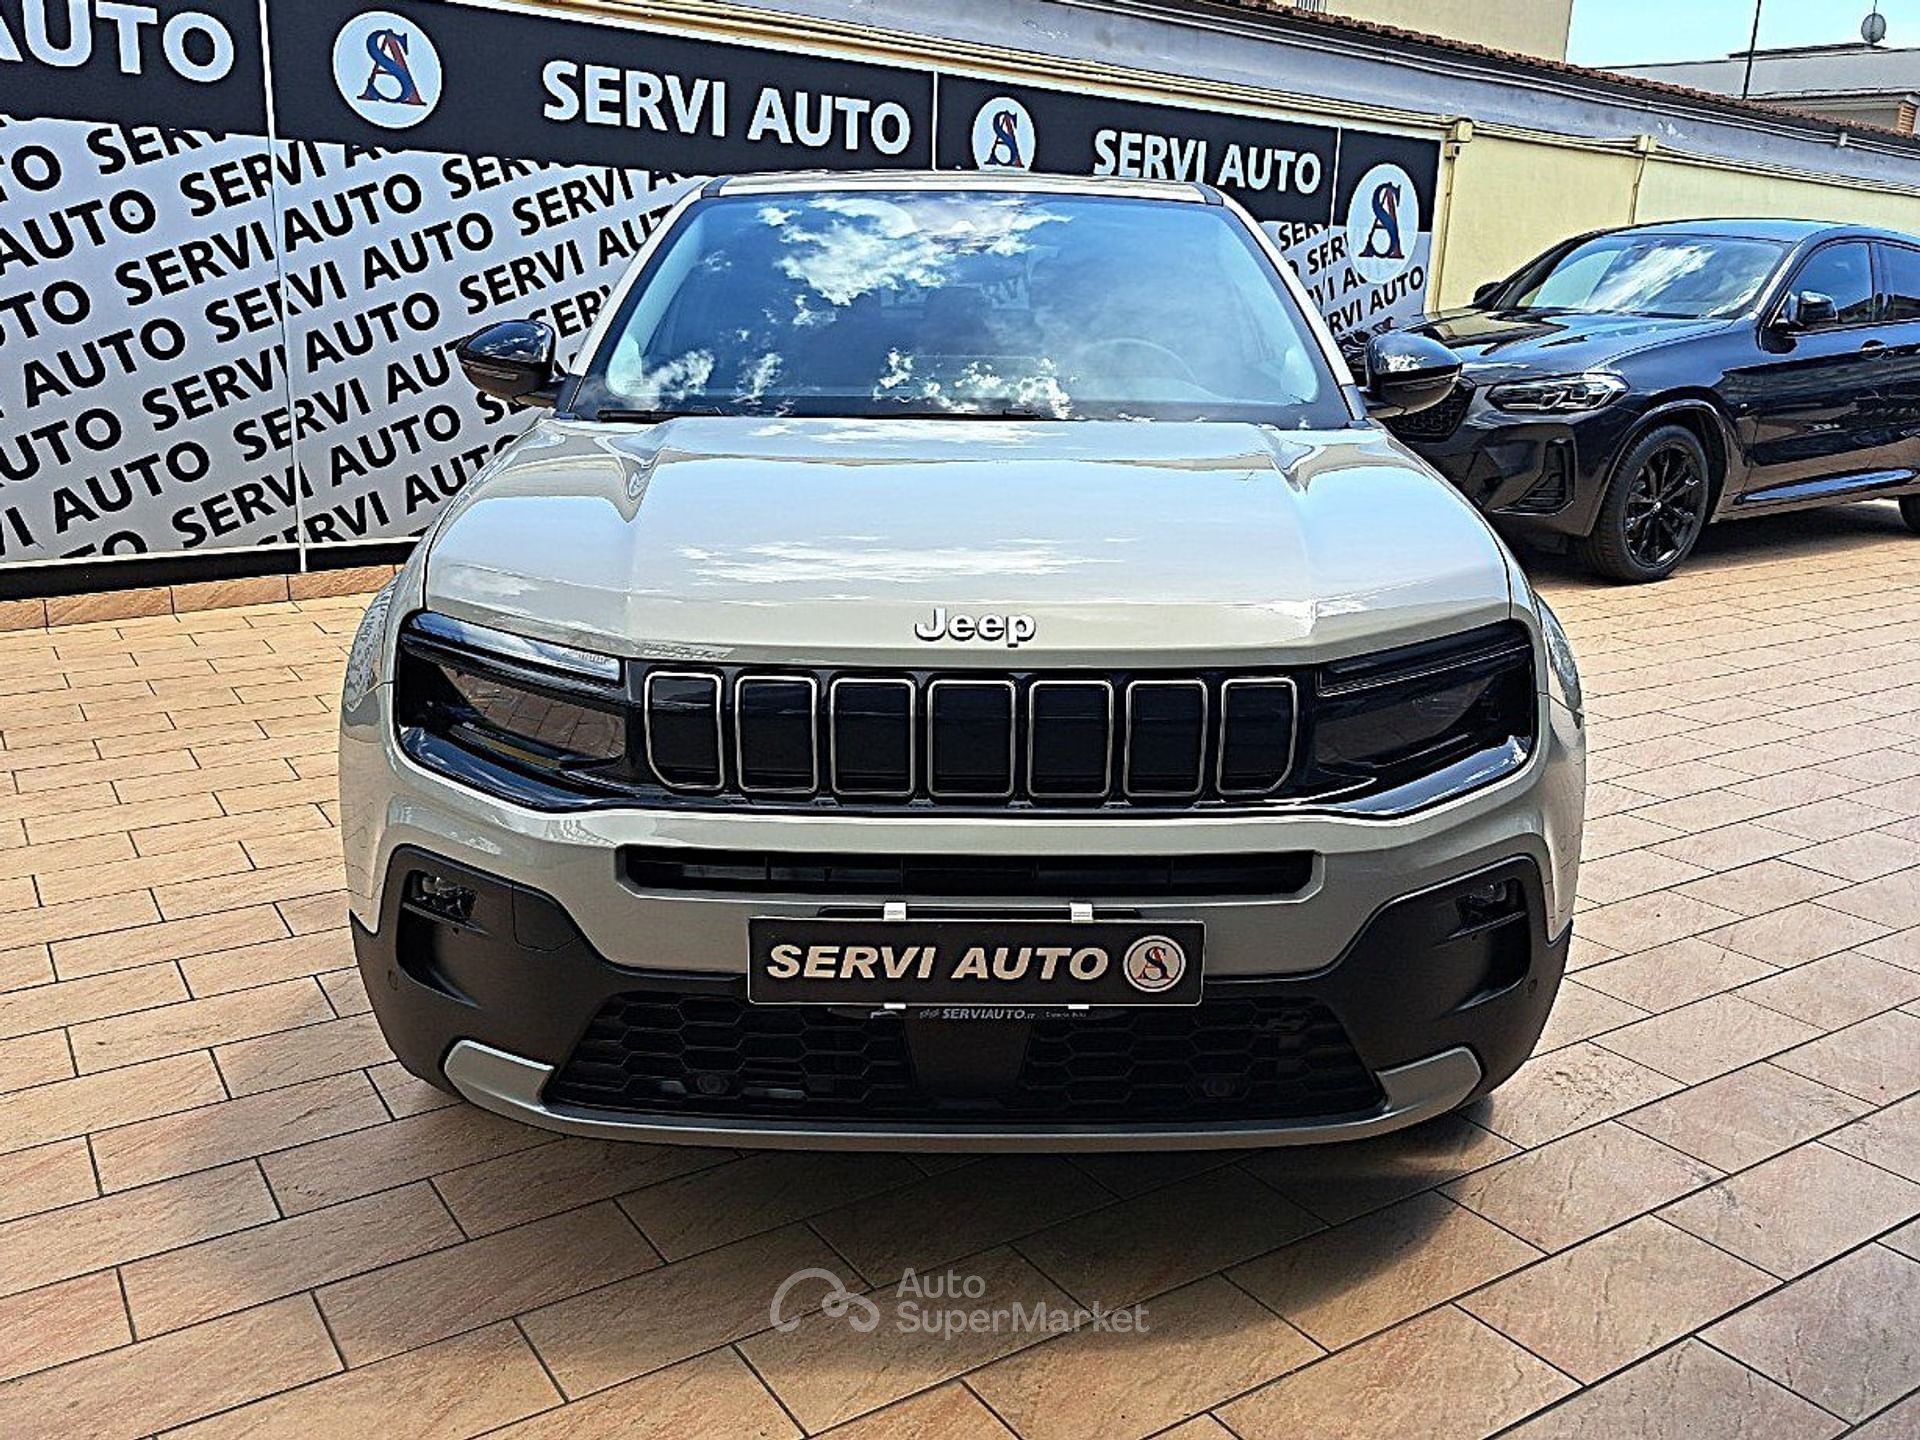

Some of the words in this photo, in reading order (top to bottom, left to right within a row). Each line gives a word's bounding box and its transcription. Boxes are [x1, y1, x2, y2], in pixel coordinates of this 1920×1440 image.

[541, 60, 726, 138] SERVI
[747, 88, 911, 155] AUTO
[86, 125, 226, 175] SER
[1093, 129, 1207, 184] SERVI
[1216, 144, 1321, 194] AUTO
[0, 189, 156, 275] AUTO
[180, 140, 326, 217] SERVI
[115, 221, 275, 306] SERVI
[284, 173, 422, 252] AUTO
[442, 157, 552, 199] SER
[24, 318, 186, 408] AUTO
[205, 260, 347, 343] SERVI
[364, 212, 493, 290] AUTO
[512, 168, 635, 237] SERVI
[1307, 231, 1349, 275] SER
[1323, 298, 1363, 338] RVI
[1369, 265, 1424, 315] AUTO
[0, 407, 122, 487] UTO
[142, 344, 288, 432] SERVI
[304, 292, 441, 373] AUTO
[460, 239, 585, 314] SERVI
[53, 440, 210, 534] AUTO
[233, 377, 371, 462] SERVI
[171, 465, 314, 548] SERVI
[331, 404, 461, 487] AUTO
[256, 490, 390, 547] RVI
[914, 607, 1036, 648] Jeep
[766, 944, 937, 980] SERVI
[951, 947, 1109, 981] AUTO
